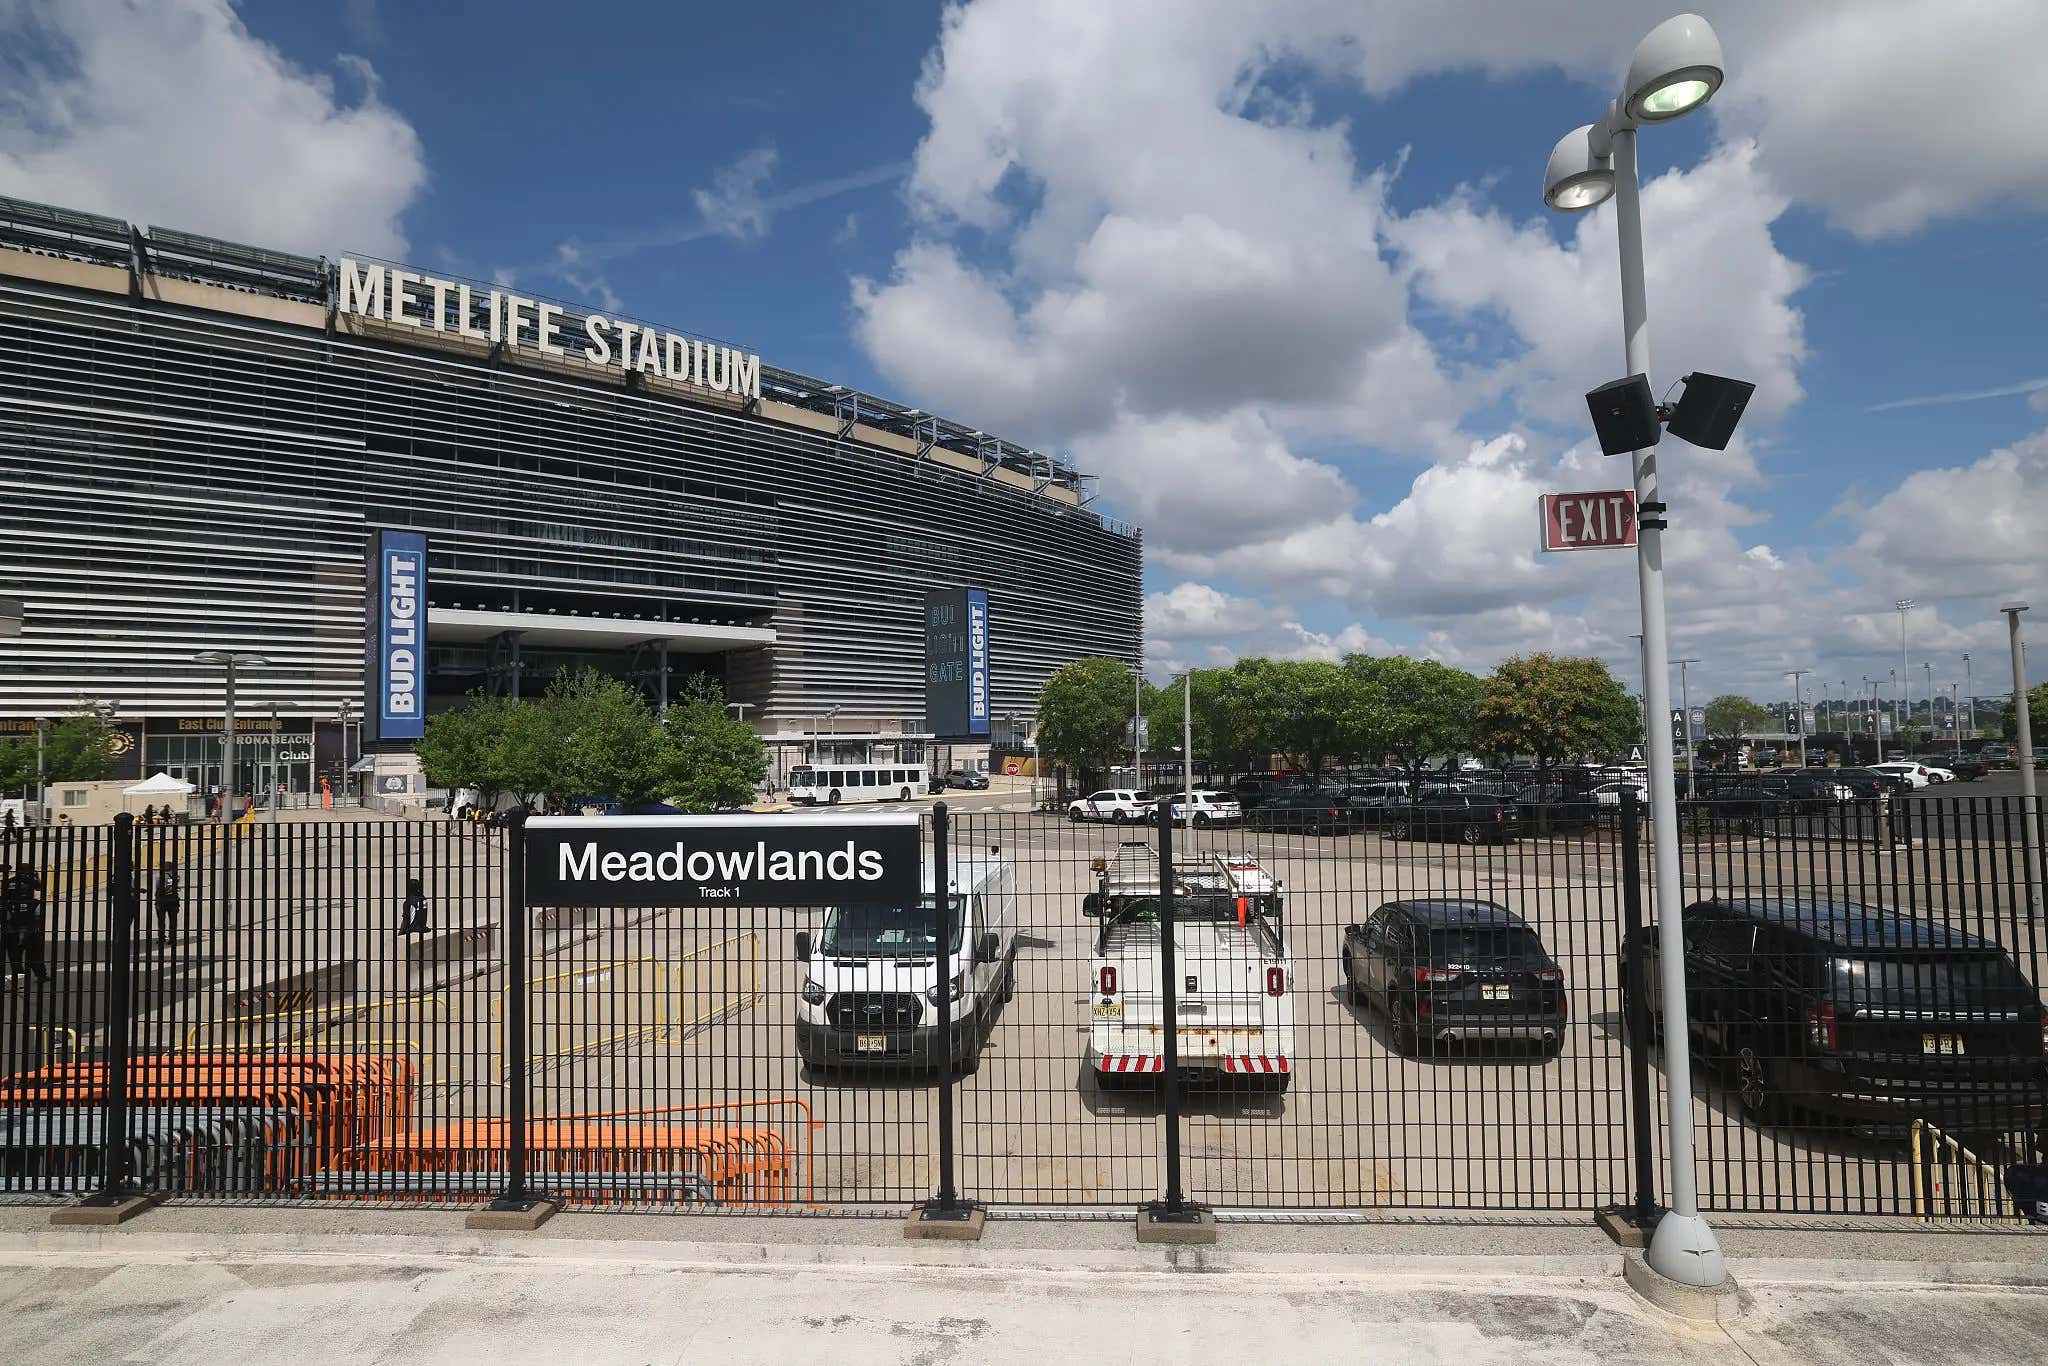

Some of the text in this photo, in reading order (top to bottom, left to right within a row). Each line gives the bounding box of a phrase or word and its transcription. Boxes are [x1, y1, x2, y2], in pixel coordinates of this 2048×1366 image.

[339, 258, 760, 398] METLIFE STADIUM
[1559, 498, 1624, 543] EXIT
[390, 555, 416, 713] BUD LIGHT
[972, 606, 985, 717] BUD LIGHT
[929, 660, 963, 683] GATE
[1673, 712, 1682, 722] A
[1788, 713, 1796, 721] A
[179, 719, 203, 730] East
[207, 719, 225, 730] Clu
[1790, 725, 1797, 733] 2
[1675, 728, 1682, 737] 6
[280, 750, 310, 761] Club
[1630, 746, 1642, 761] A
[558, 840, 884, 882] Meadowlands
[699, 886, 740, 898] Track 1
